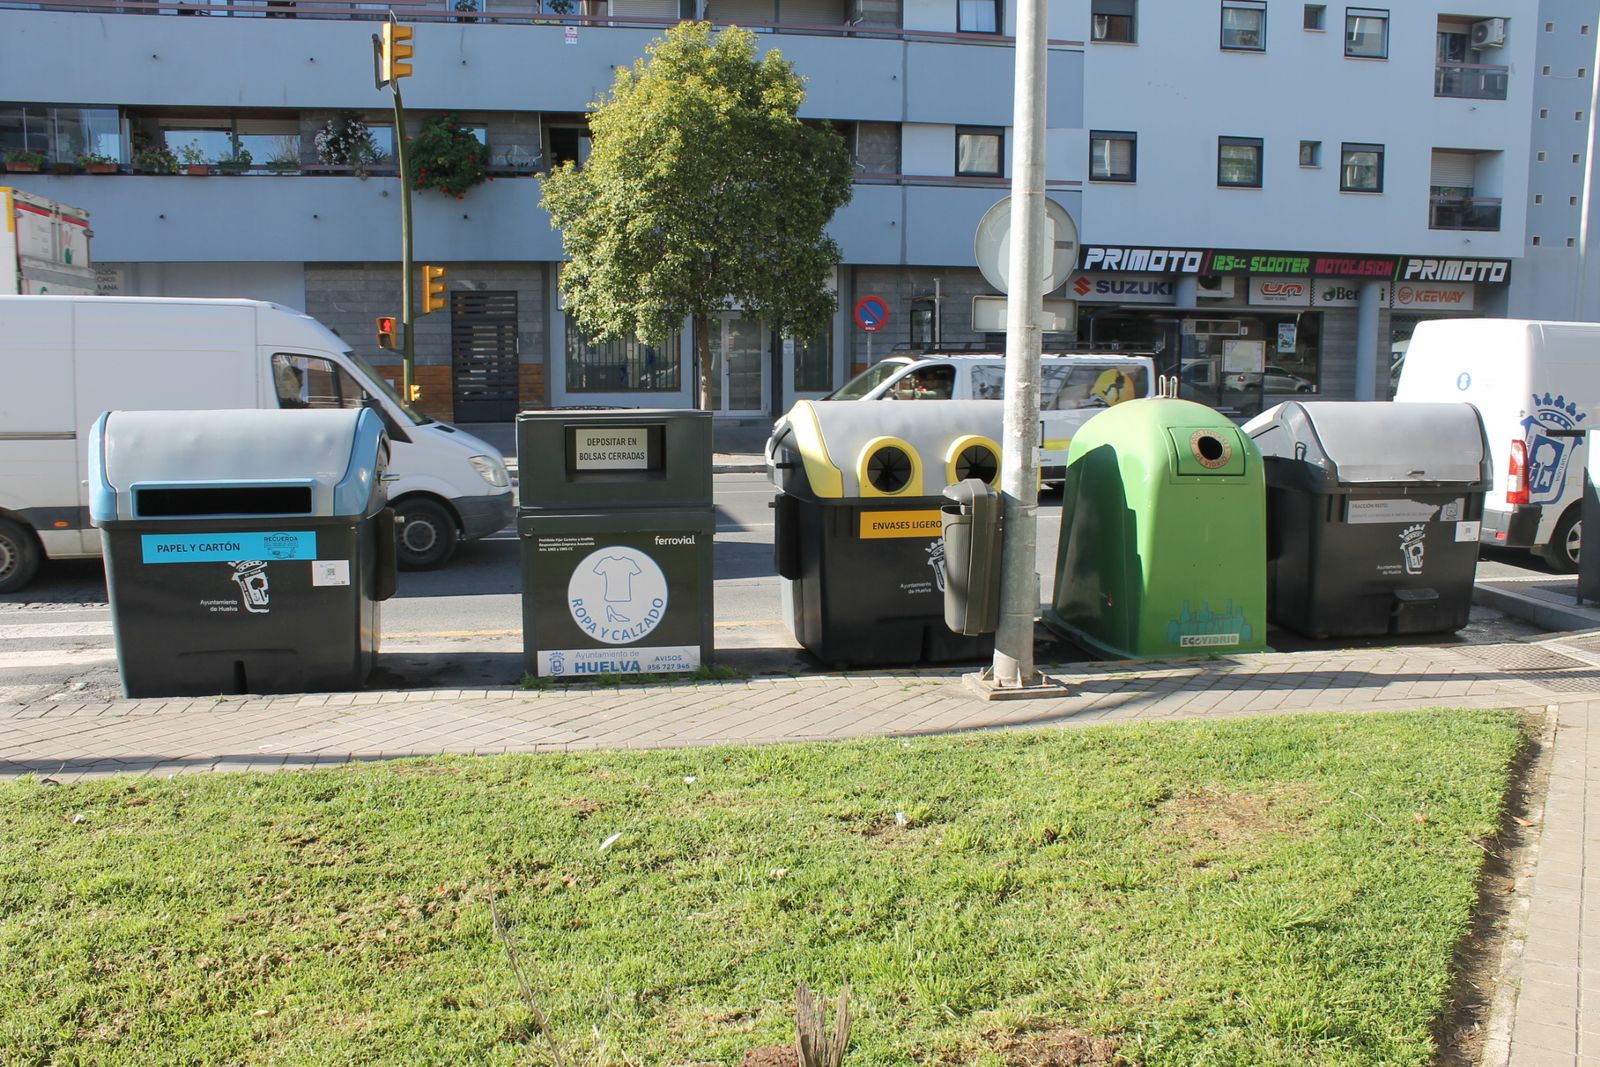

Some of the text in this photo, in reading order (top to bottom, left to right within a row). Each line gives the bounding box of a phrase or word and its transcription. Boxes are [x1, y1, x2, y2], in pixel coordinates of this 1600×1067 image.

[1083, 247, 1203, 273] PRIMOTO
[1212, 255, 1247, 271] 125cc
[1250, 256, 1310, 273] SCOOTER
[1315, 258, 1394, 276] MOTOCASION
[1404, 259, 1509, 283] PRIMOTO
[1096, 280, 1173, 296] SUZUKI
[1414, 289, 1465, 303] KEEWAY
[586, 438, 637, 446] DEPOSITAR EN
[579, 452, 645, 460] BOLSAS CERRADAS
[872, 520, 942, 530] ENVASES LIGERO
[157, 542, 240, 553] PAPEL Y CARTÓN
[654, 535, 696, 546] ferrovial
[572, 598, 664, 641] ROPA Y CALZADO
[576, 651, 628, 659] Ayuntamiento
[574, 660, 642, 673] HUELVA
